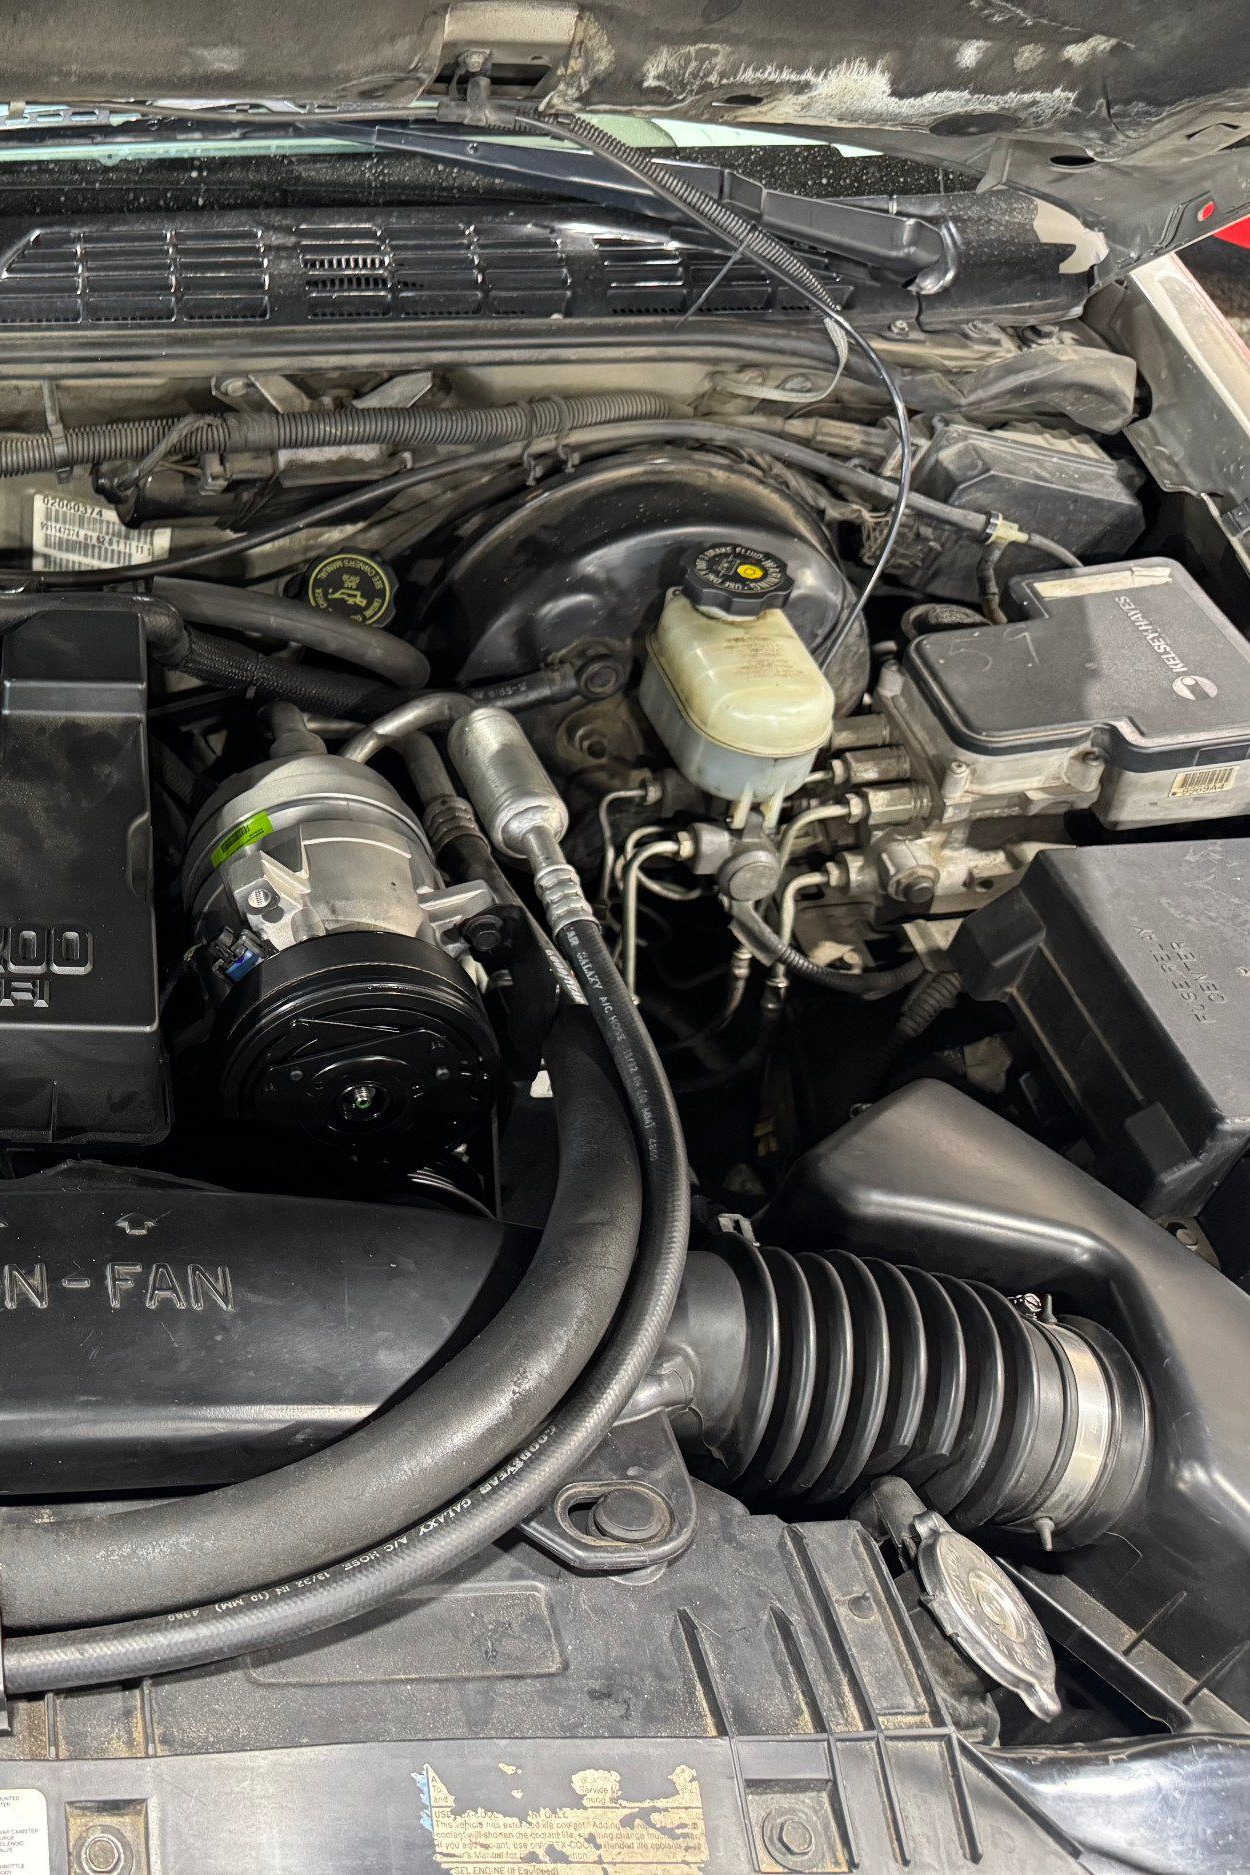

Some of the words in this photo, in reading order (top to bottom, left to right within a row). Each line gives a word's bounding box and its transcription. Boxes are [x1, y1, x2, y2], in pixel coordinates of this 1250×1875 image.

[317, 560, 343, 579] MANUAL
[372, 576, 383, 590] SEE
[576, 951, 603, 990] GALAXY
[608, 1015, 626, 1041] HOSE
[105, 1262, 236, 1312] FAN
[480, 1425, 556, 1494] GOODYEAR
[419, 1499, 472, 1536] GALAXY
[384, 1536, 408, 1552] A/C
[344, 1550, 380, 1571] HOSE
[297, 1571, 330, 1588] 13/32
[215, 1599, 245, 1612] MM)
[455, 1821, 484, 1829] vehicle
[530, 1832, 559, 1840] coolant
[615, 1832, 645, 1841] change
[445, 1843, 459, 1852] you
[473, 1866, 506, 1875] ENGINE
